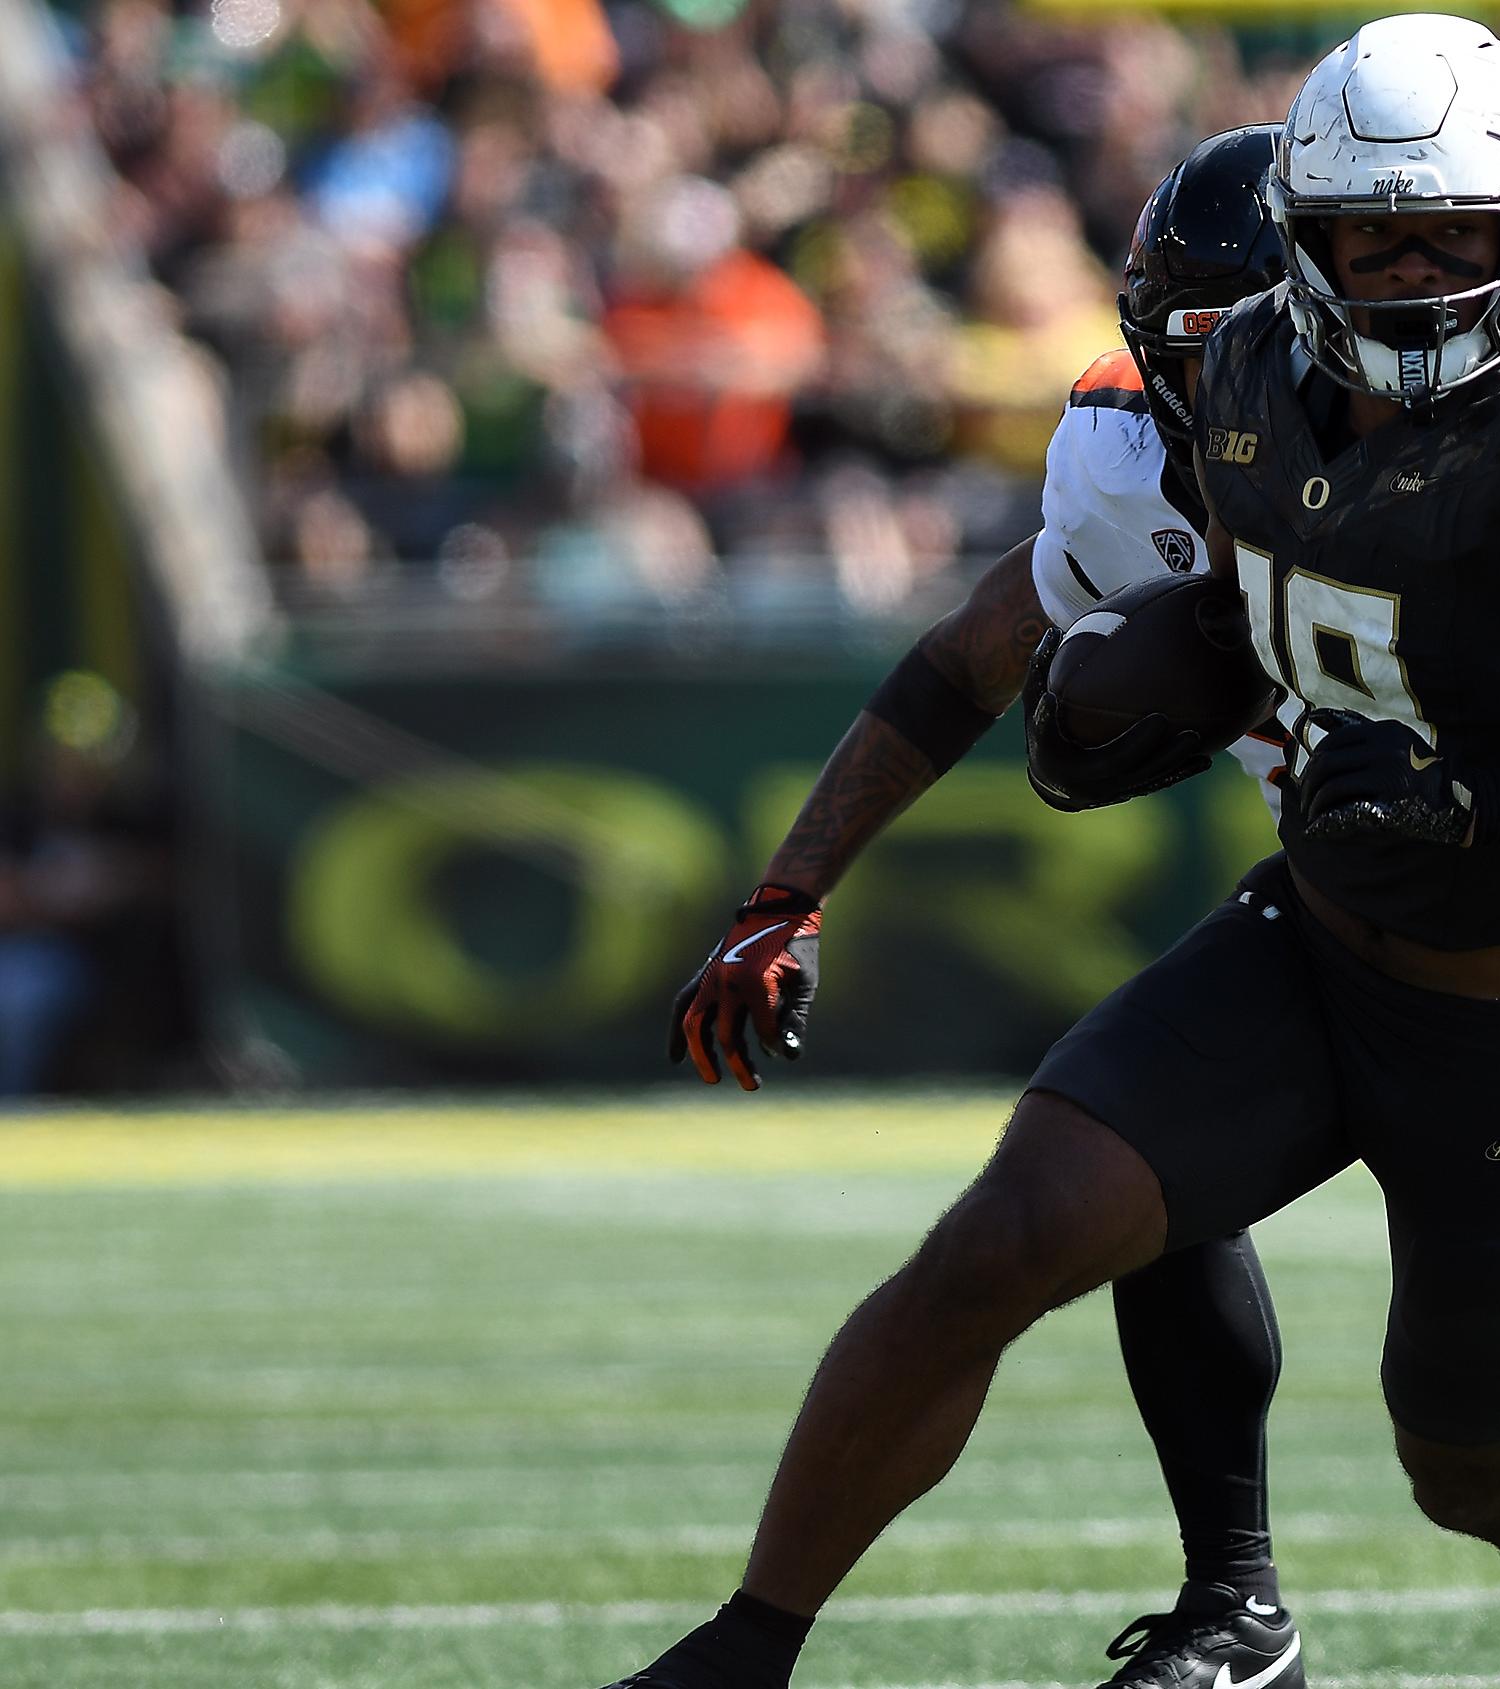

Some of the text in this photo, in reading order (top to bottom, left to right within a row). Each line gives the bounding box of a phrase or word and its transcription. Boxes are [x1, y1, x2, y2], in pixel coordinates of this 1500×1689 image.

[1372, 169, 1414, 195] nike
[1302, 476, 1330, 510] O
[1391, 470, 1427, 493] nike
[1154, 532, 1191, 563] PAC
[1168, 553, 1187, 572] 12
